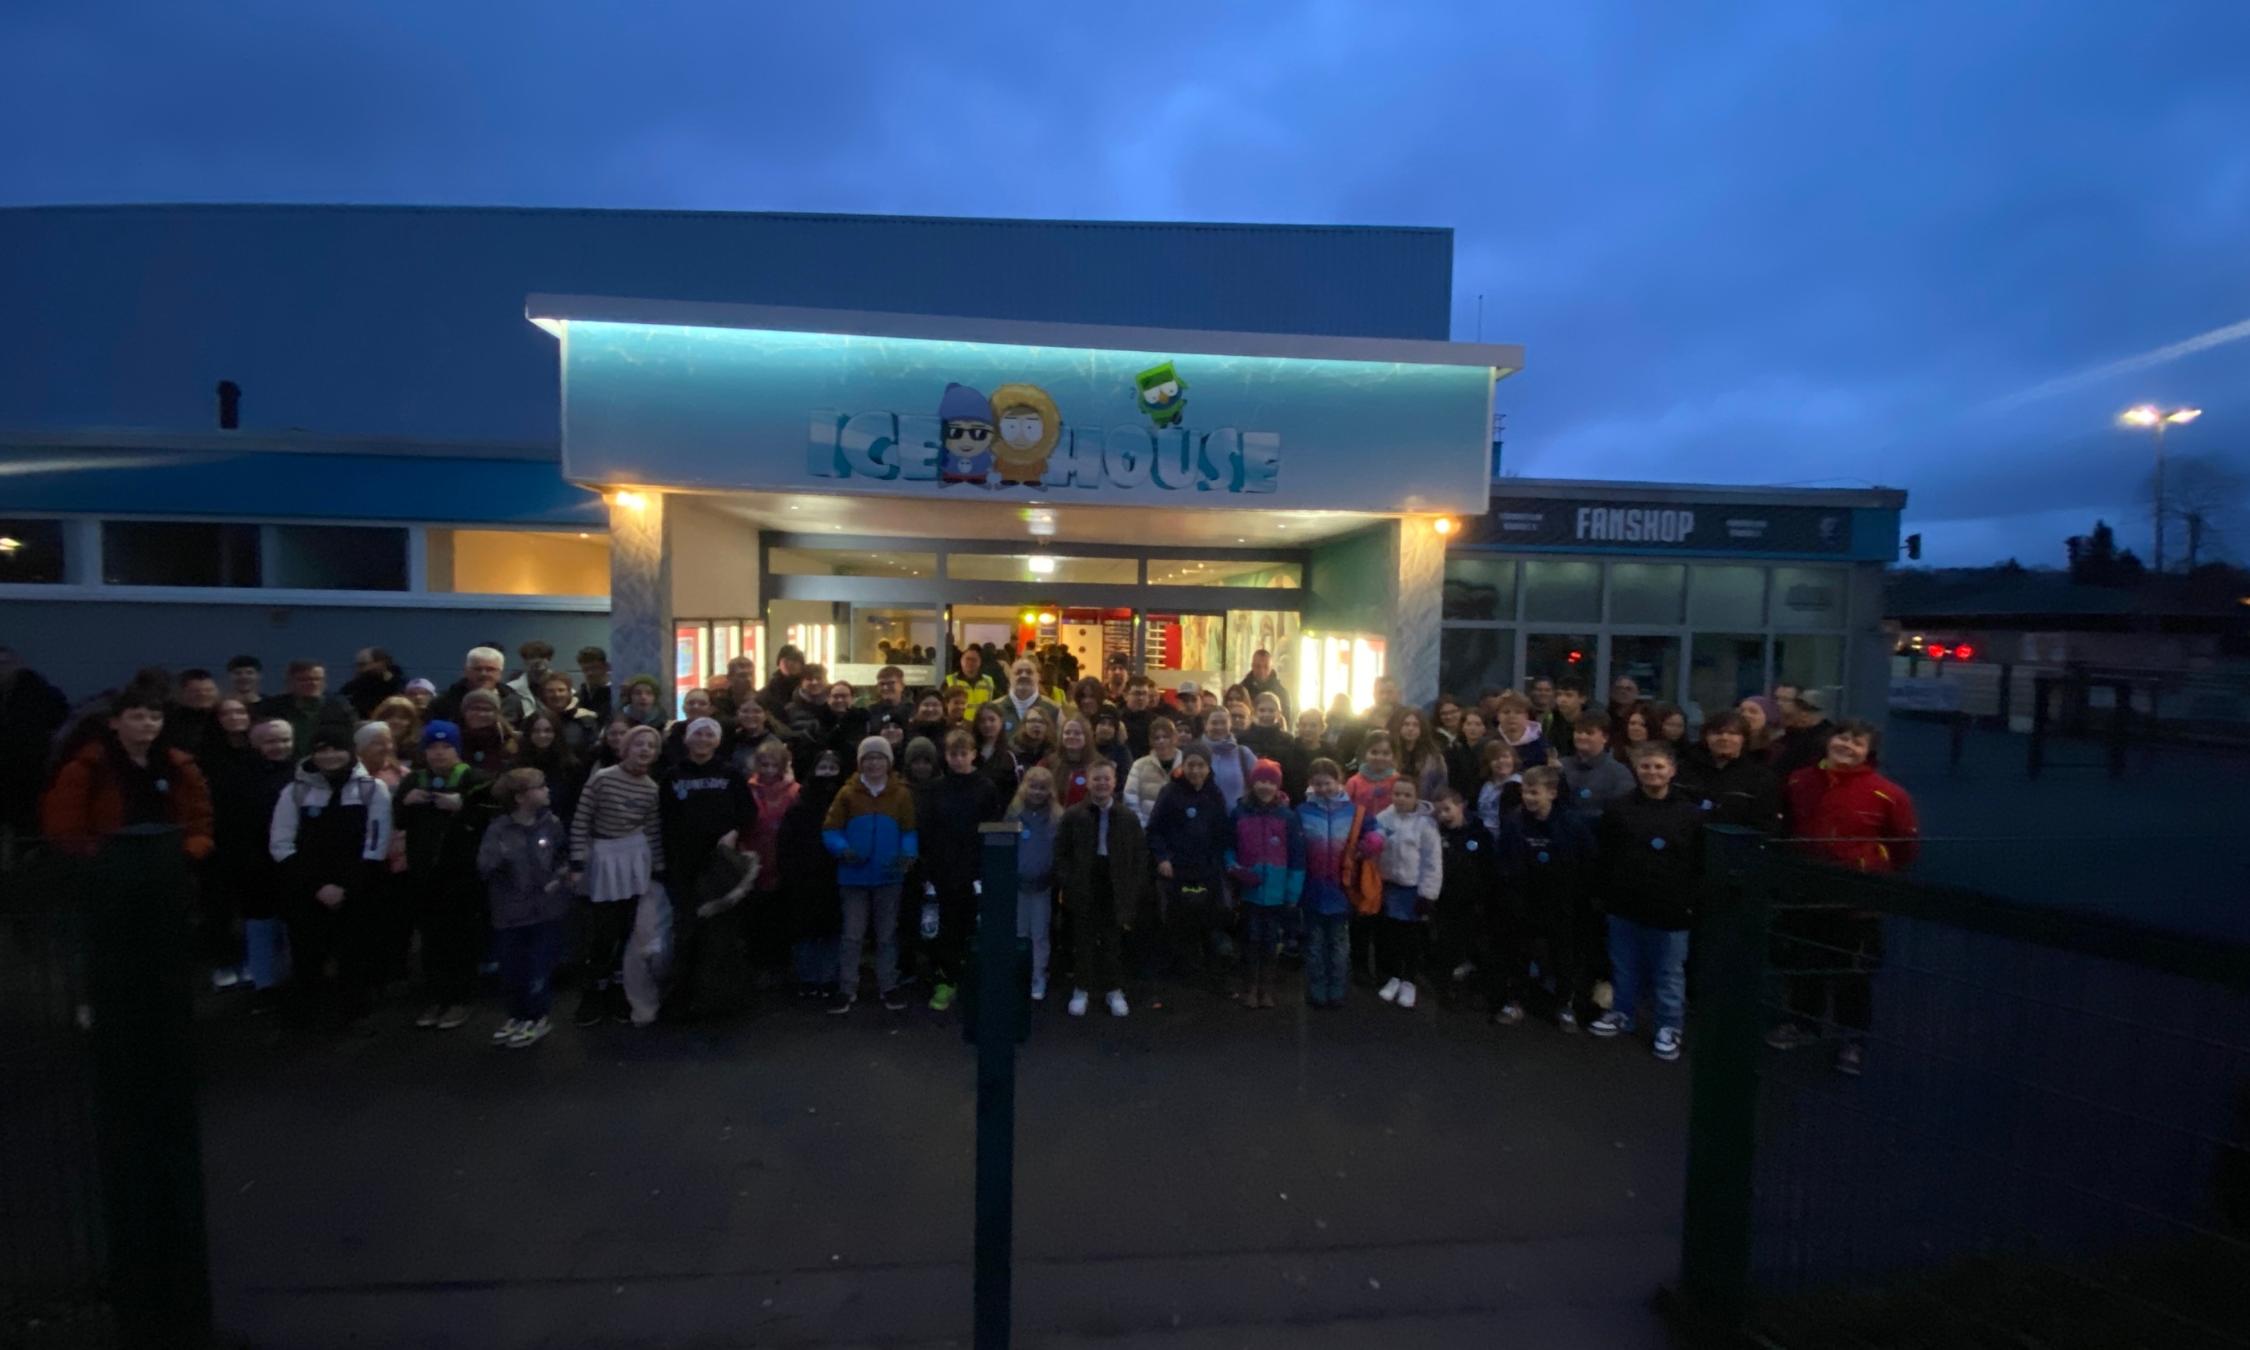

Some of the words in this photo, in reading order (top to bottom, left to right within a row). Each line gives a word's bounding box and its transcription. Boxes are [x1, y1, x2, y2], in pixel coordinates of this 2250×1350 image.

[808, 410, 943, 481] ICE
[1044, 425, 1280, 493] HOUSE
[1576, 507, 1695, 542] FANSHOP
